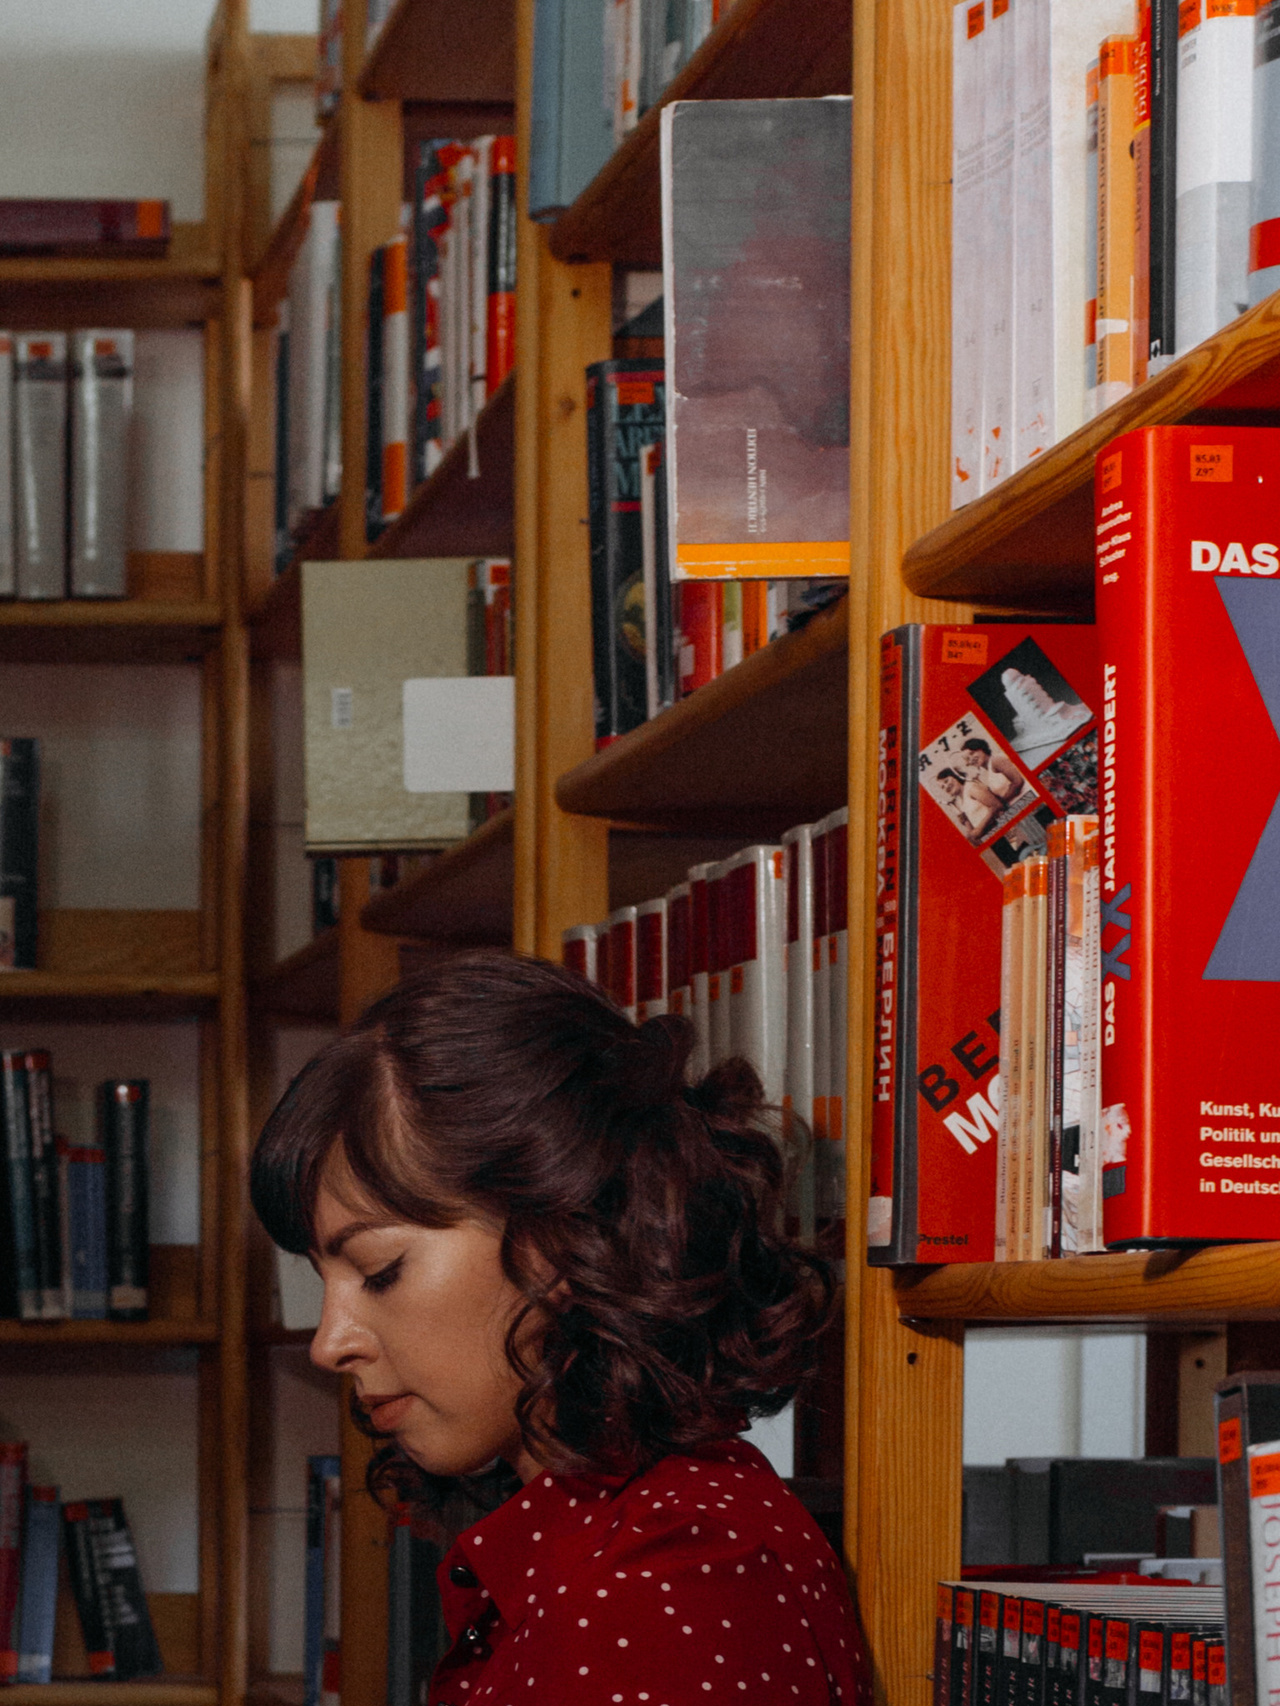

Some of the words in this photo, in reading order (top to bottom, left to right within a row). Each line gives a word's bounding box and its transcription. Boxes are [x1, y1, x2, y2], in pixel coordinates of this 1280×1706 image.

[1098, 106, 1108, 189] Literatur
[1097, 198, 1107, 297] deutschen
[747, 428, 757, 474] EDITION
[1190, 540, 1280, 576] DAS
[1103, 662, 1117, 893] JAHRHUNDERT
[878, 931, 895, 1102] БЕРЛИН
[1104, 981, 1116, 1046] DAS
[1200, 1101, 1256, 1120] Kunst,
[1200, 1127, 1257, 1143] Politik
[1199, 1178, 1216, 1193] in
[1220, 1178, 1280, 1195] Deutsc
[919, 1233, 969, 1247] Prestel
